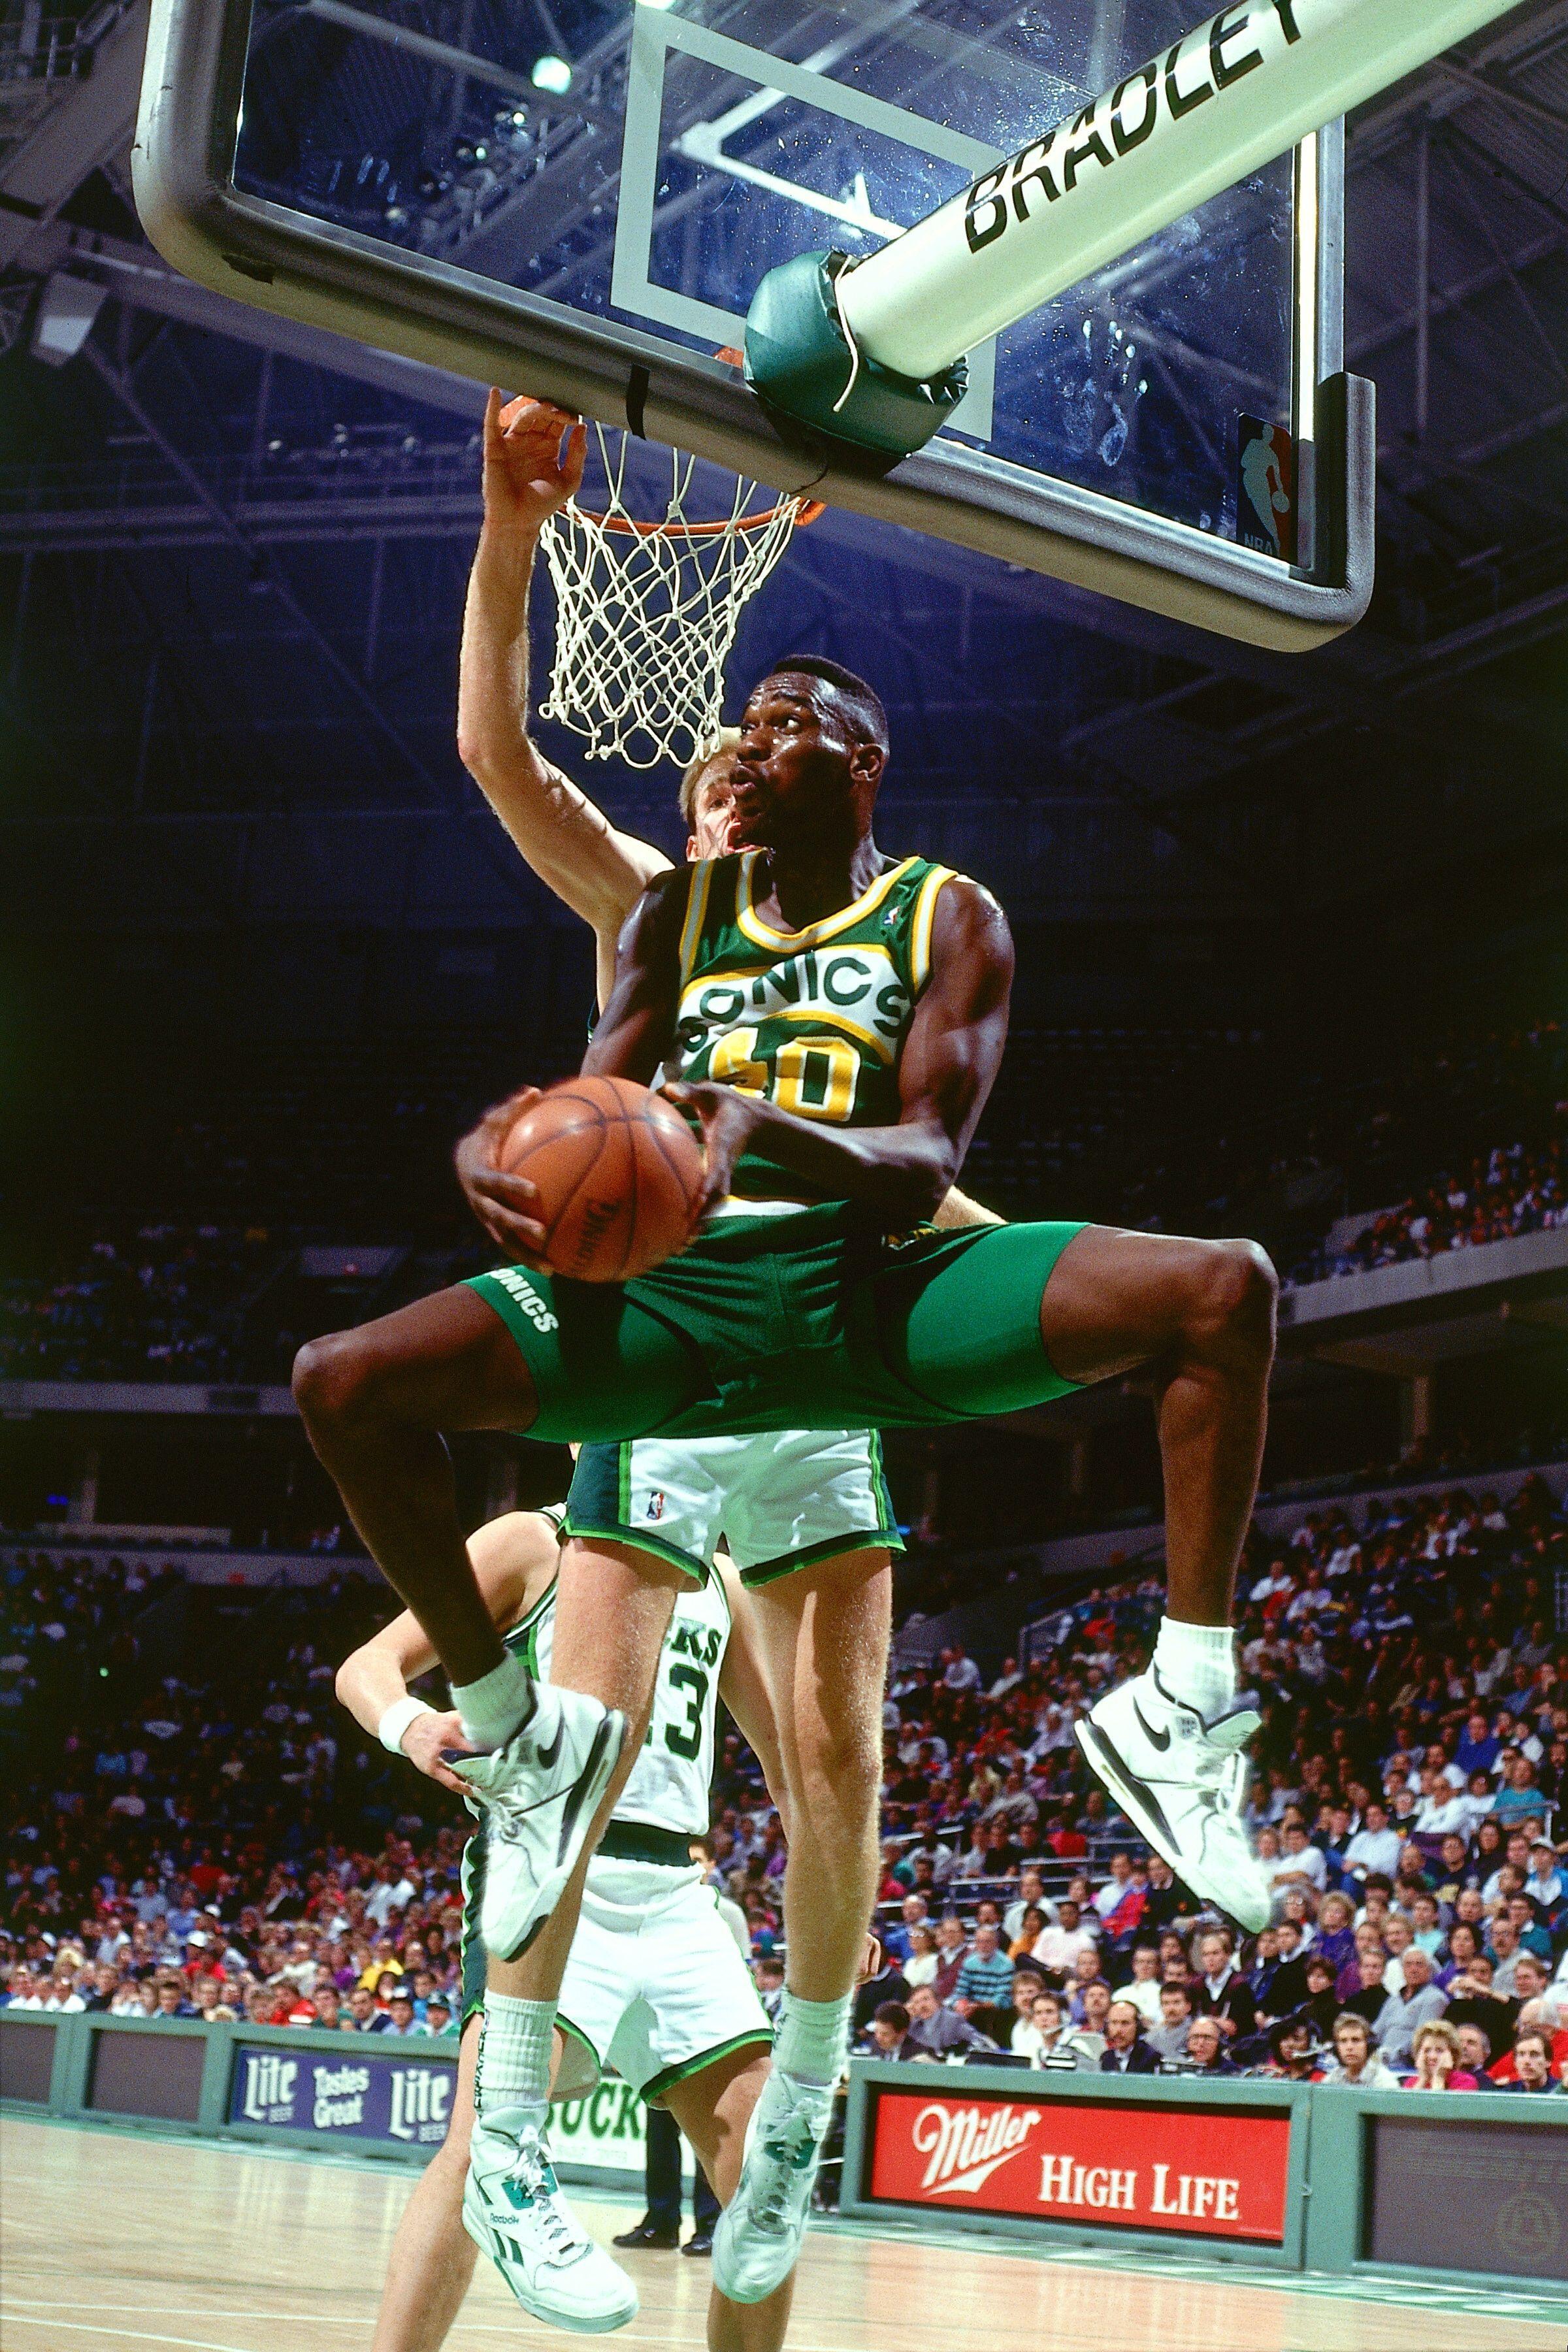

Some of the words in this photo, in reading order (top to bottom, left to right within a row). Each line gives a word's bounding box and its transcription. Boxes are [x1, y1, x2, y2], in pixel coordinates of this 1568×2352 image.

[678, 950, 910, 1053] SONICS
[708, 1026, 860, 1122] 40
[664, 1615, 723, 1669] KS
[645, 1662, 710, 1762] 3
[244, 2055, 298, 2121] Lite
[314, 2065, 370, 2099] Tastes
[314, 2095, 363, 2129] Great
[389, 2068, 450, 2140] Lite
[913, 2104, 1042, 2189] Miller
[1039, 2154, 1136, 2210] HIGH
[1151, 2163, 1240, 2221] LIFE
